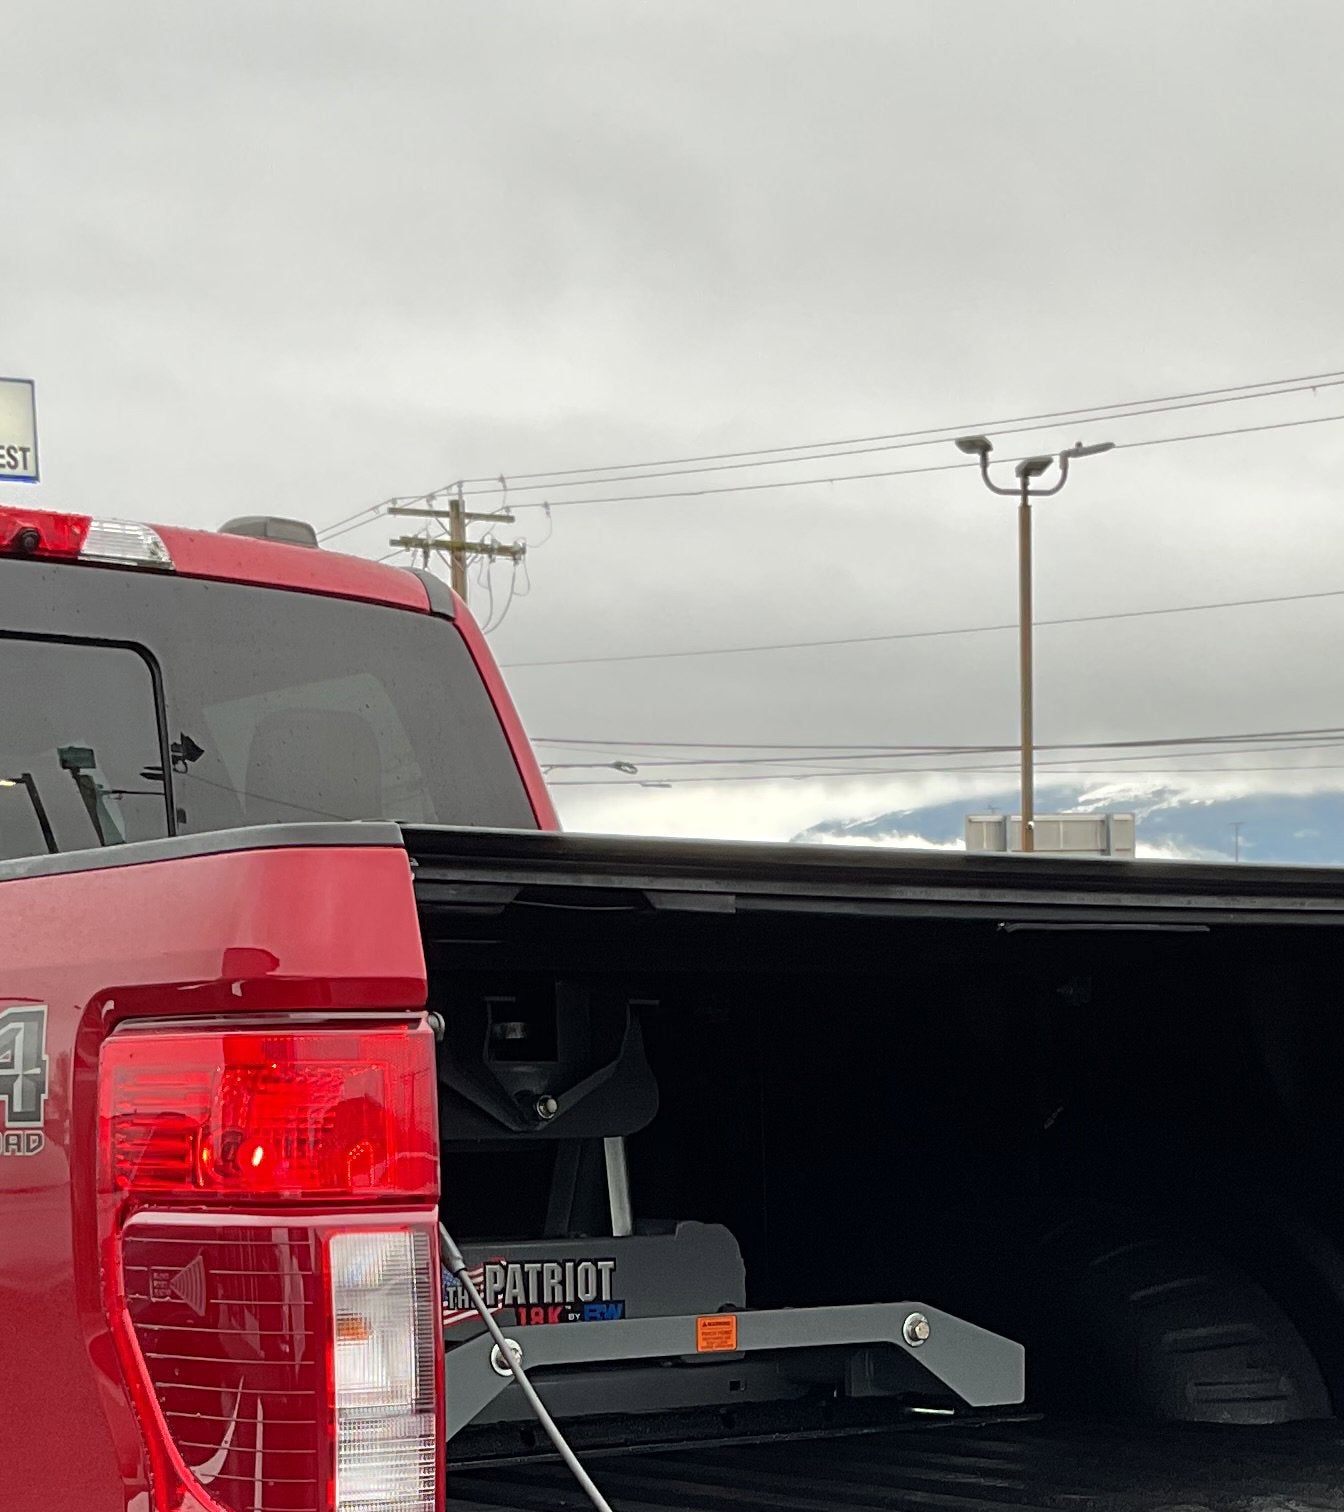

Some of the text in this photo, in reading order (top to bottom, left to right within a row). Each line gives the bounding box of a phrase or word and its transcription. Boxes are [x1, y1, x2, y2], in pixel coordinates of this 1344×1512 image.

[446, 1260, 616, 1309] TH PATRIOT
[517, 1305, 564, 1327] 18K
[567, 1313, 581, 1321] BY
